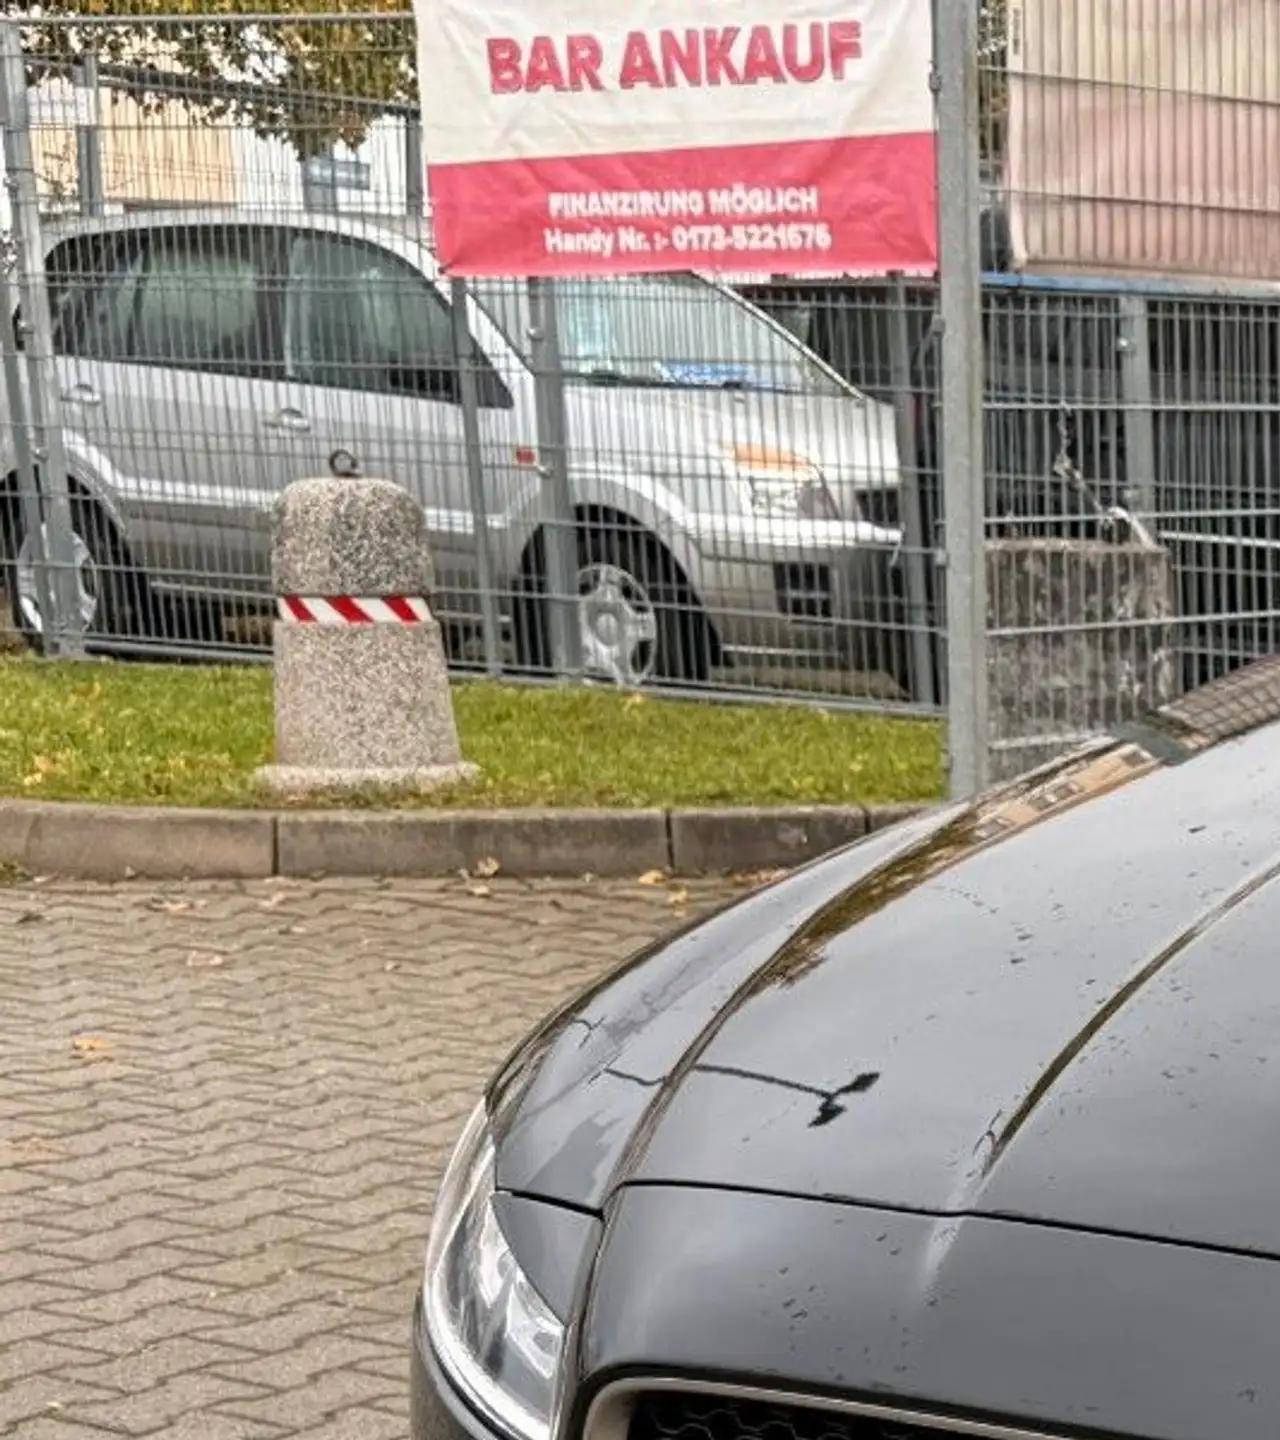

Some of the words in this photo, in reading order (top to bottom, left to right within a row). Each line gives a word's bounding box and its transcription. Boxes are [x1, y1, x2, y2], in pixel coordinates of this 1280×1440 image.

[486, 33, 606, 95] BAR
[618, 20, 863, 90] ANKAUF
[549, 189, 704, 218] FINANZIRUNG
[708, 182, 818, 216] MÖGLICH
[544, 227, 613, 257] Handy
